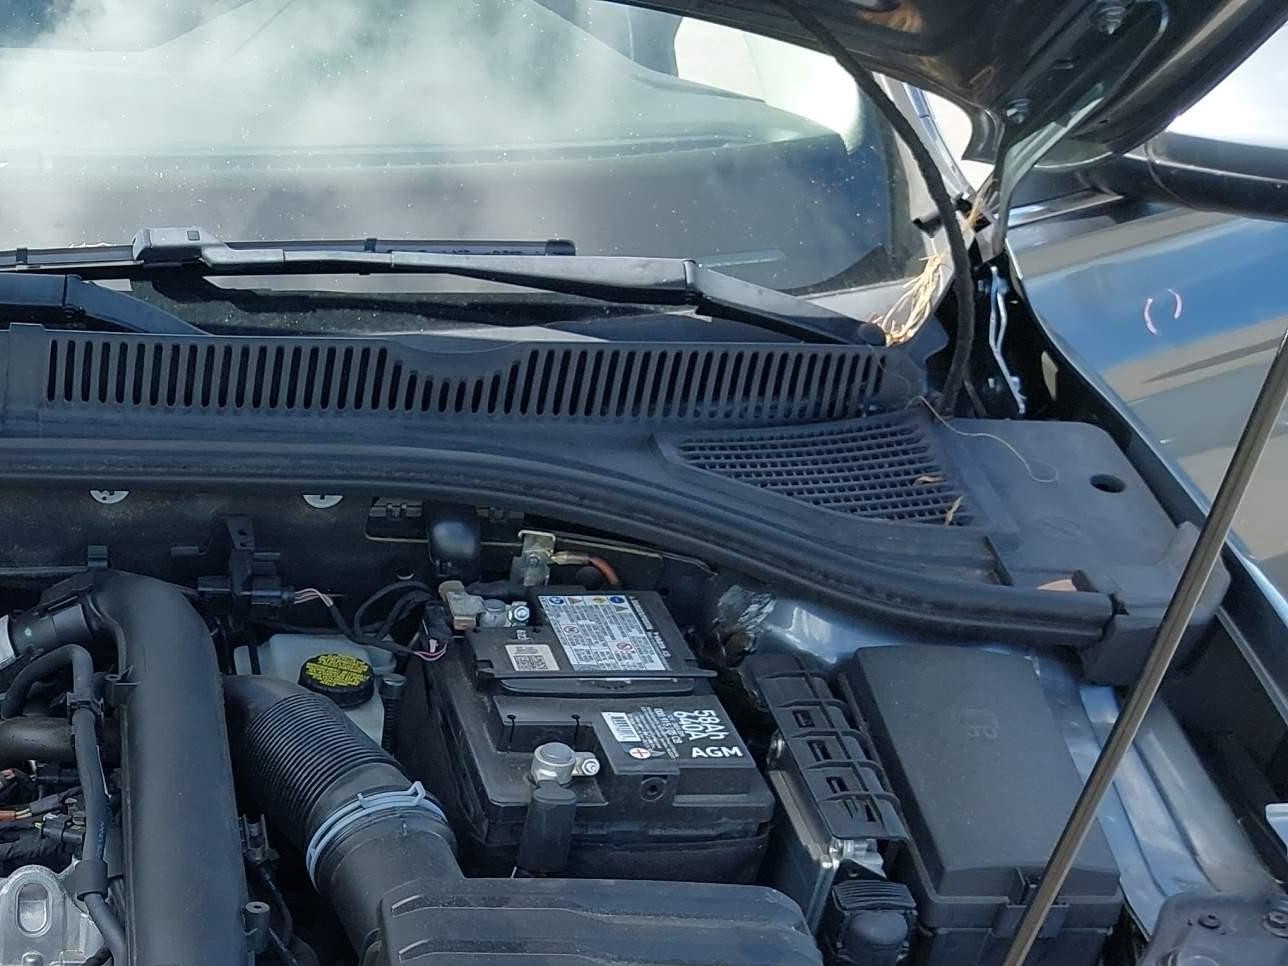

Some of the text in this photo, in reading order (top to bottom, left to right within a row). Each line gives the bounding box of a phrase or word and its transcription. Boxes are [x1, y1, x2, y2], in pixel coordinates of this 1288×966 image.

[673, 710, 709, 741] 640A
[694, 709, 729, 740] 58Ah
[692, 746, 743, 758] AGM
